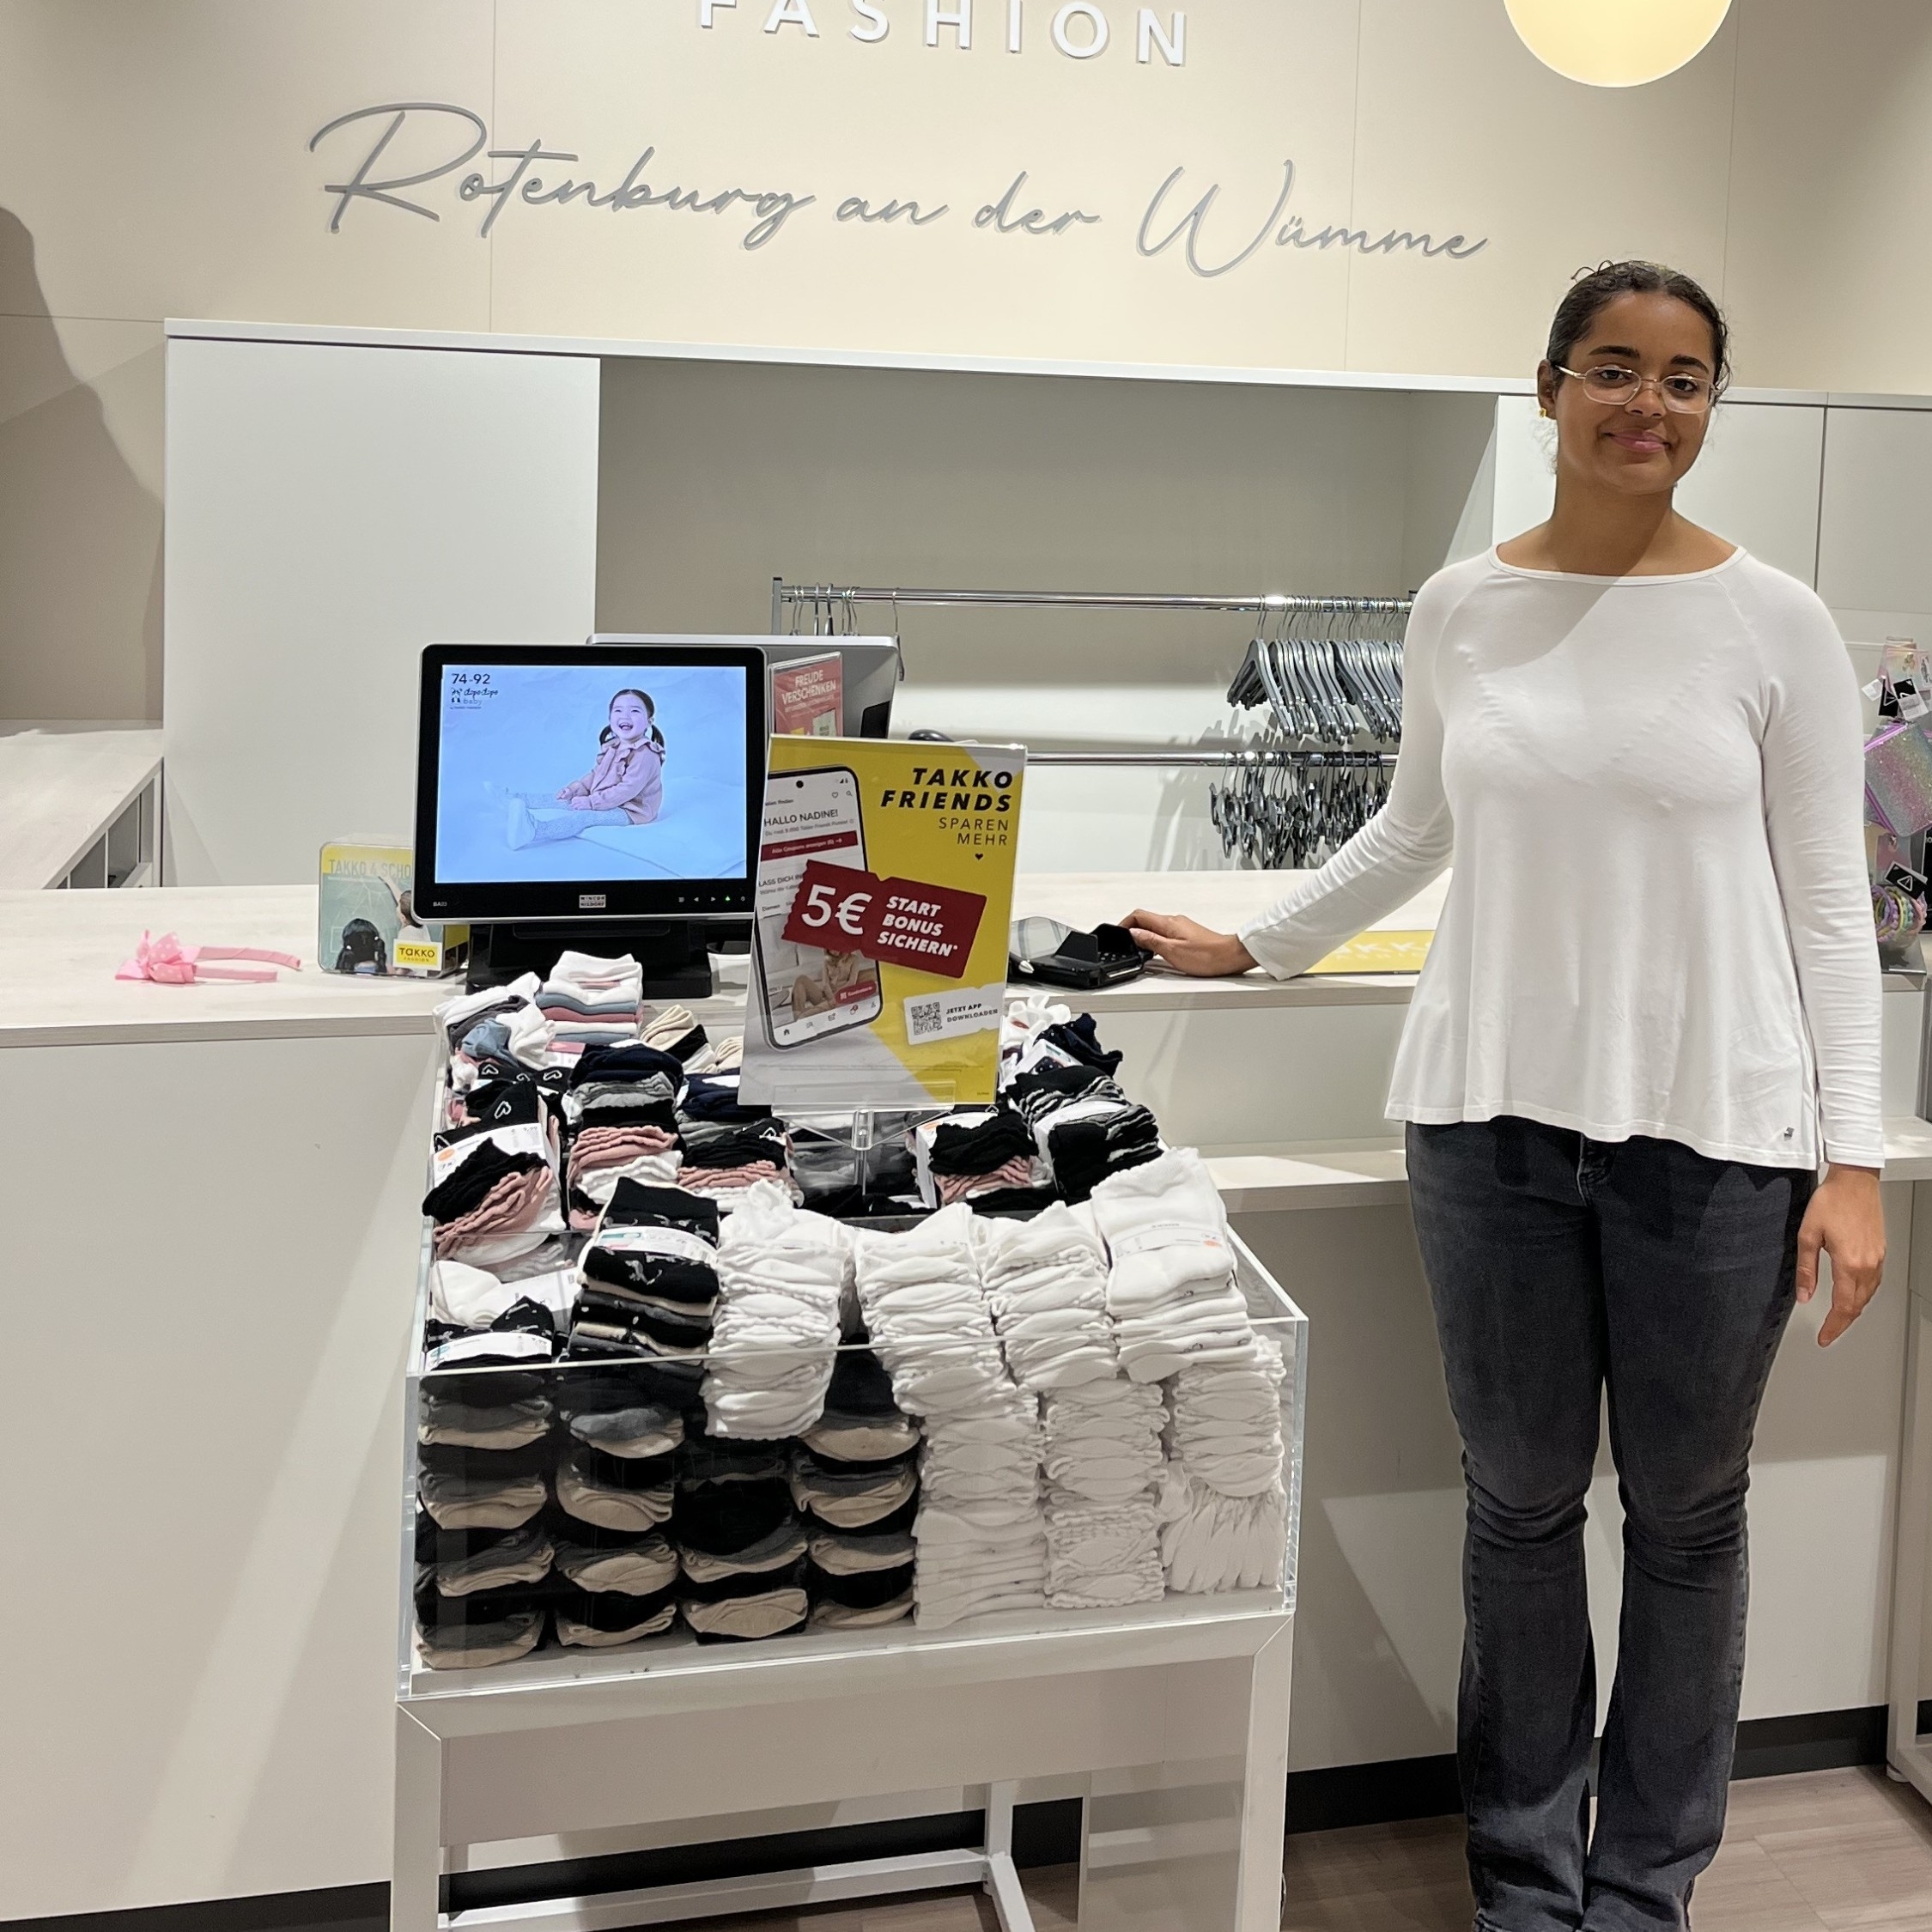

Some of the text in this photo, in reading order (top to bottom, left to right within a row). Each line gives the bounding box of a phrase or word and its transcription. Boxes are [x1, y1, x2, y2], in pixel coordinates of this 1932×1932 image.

[309, 101, 1490, 277] Rotenburg an der Wümme
[795, 670, 824, 688] FREUDE
[781, 679, 837, 706] VERSCHENKEN
[913, 768, 1013, 789] TAKKO
[880, 790, 1013, 812] FRIENDS
[763, 809, 839, 827] HALLO NADINE!
[939, 817, 1010, 832] SPAREN
[957, 833, 1008, 846] MEHR
[329, 859, 367, 877] TAKKO
[801, 884, 873, 936] 5€
[886, 896, 941, 918] START
[882, 914, 945, 937] BONUS
[946, 1003, 982, 1015] JETZT APP
[946, 1009, 999, 1023] DOWNLOADEN
